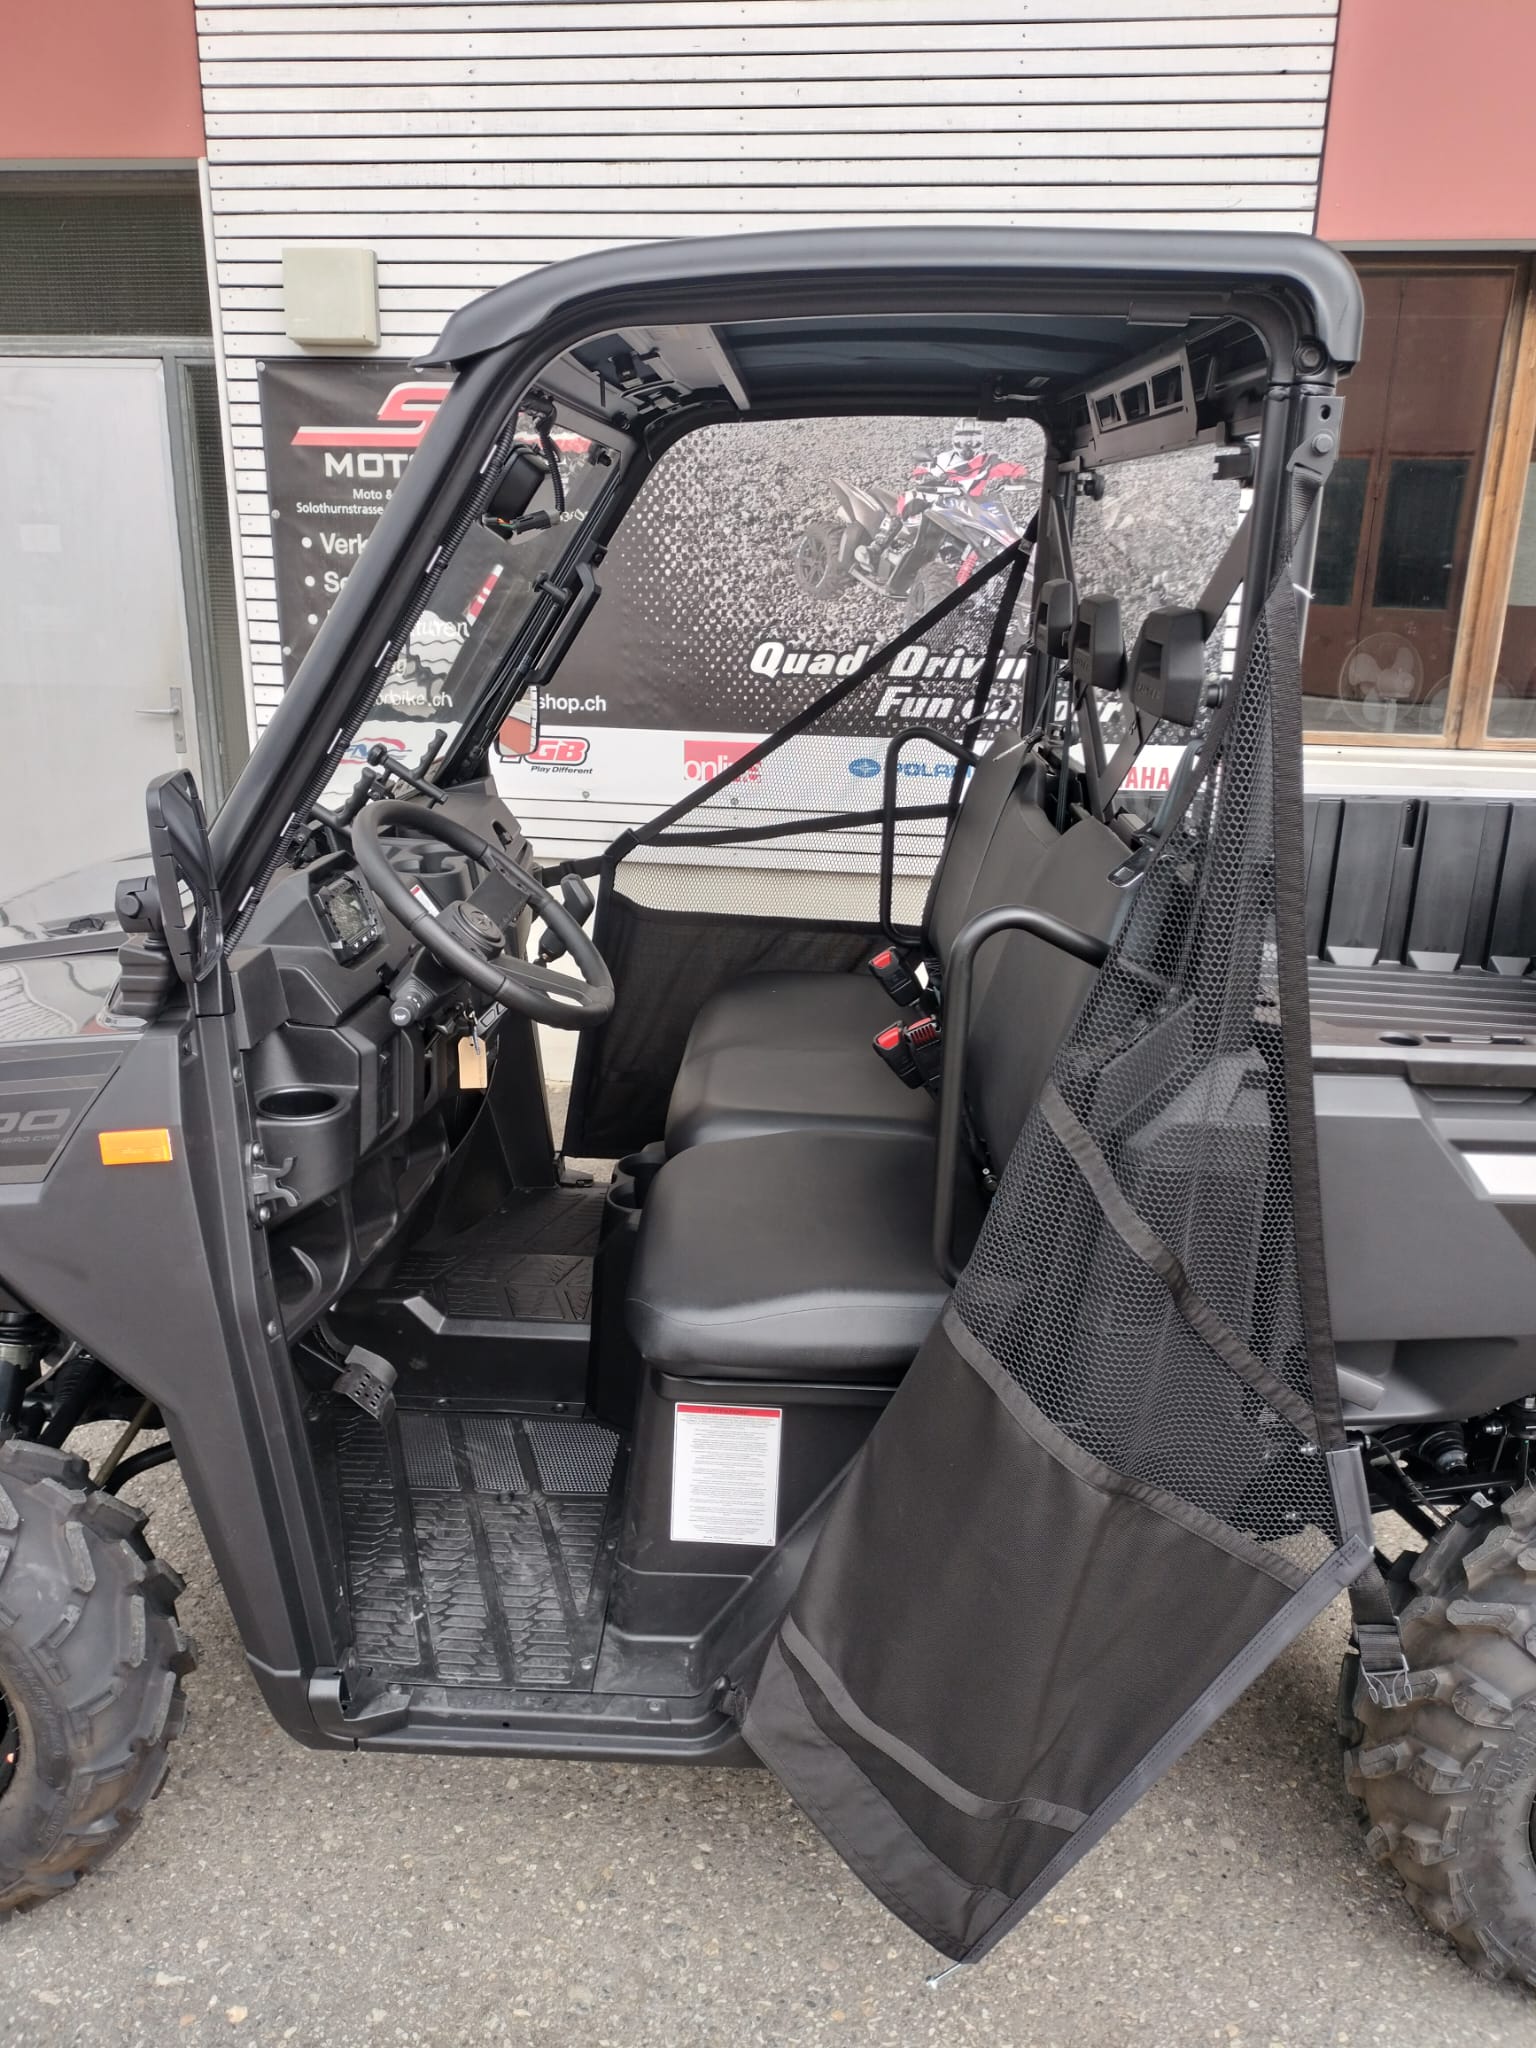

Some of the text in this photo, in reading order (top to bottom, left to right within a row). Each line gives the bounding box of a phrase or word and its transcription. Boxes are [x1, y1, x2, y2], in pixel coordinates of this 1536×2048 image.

[324, 452, 415, 478] MOT
[353, 488, 382, 500] Moto
[296, 501, 385, 515] Solothurnstrasse
[319, 532, 369, 554] Verk
[750, 641, 870, 679] Quad
[375, 690, 453, 708] orbike.ch
[539, 693, 607, 714] shop.ch
[874, 686, 955, 718] Fun
[530, 765, 593, 775] Play Different
[1124, 766, 1170, 789] AHA
